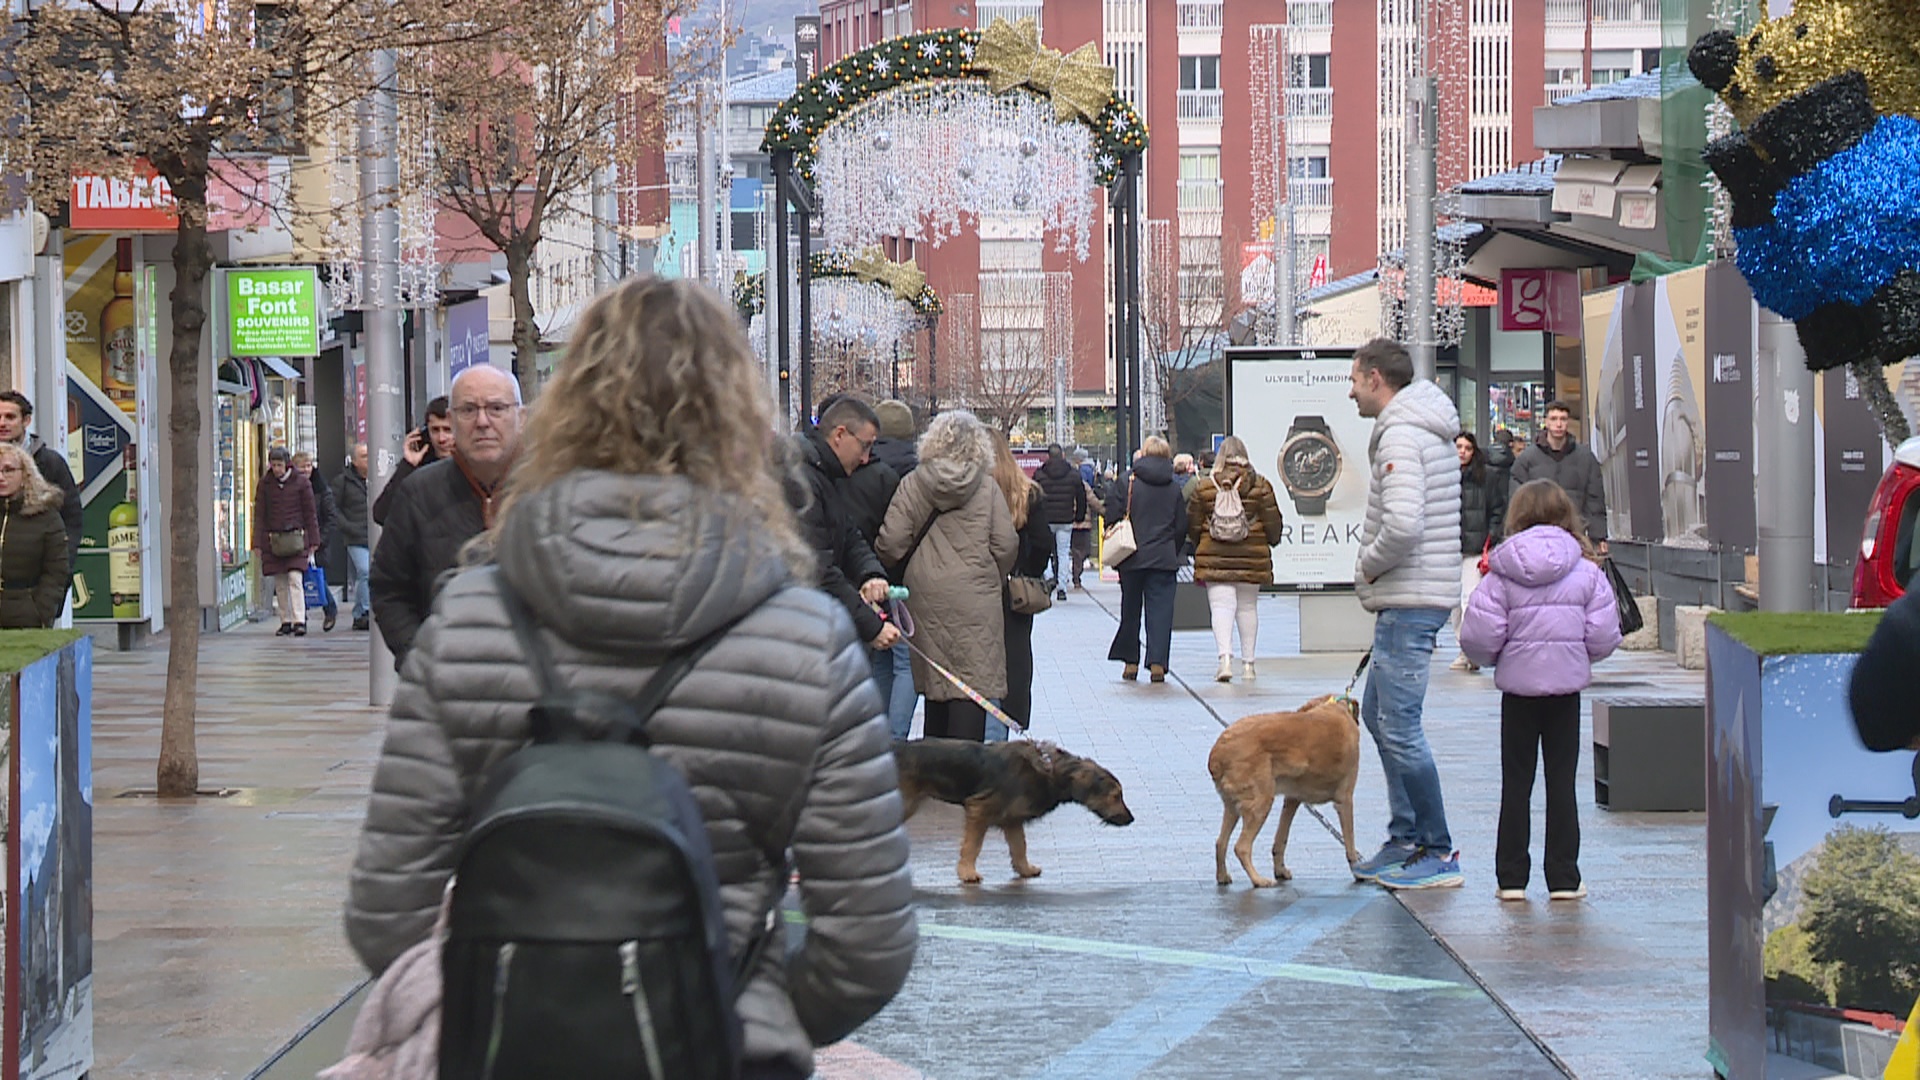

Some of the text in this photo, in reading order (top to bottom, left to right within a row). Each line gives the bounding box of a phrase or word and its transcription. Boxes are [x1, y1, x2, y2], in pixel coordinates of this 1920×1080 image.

[72, 175, 178, 209] TABAC
[238, 277, 304, 296] Basar
[247, 297, 297, 315] Font
[236, 316, 310, 328] SOUVENIRS
[1265, 375, 1304, 383] ULYSSE
[1280, 523, 1361, 545] REAK
